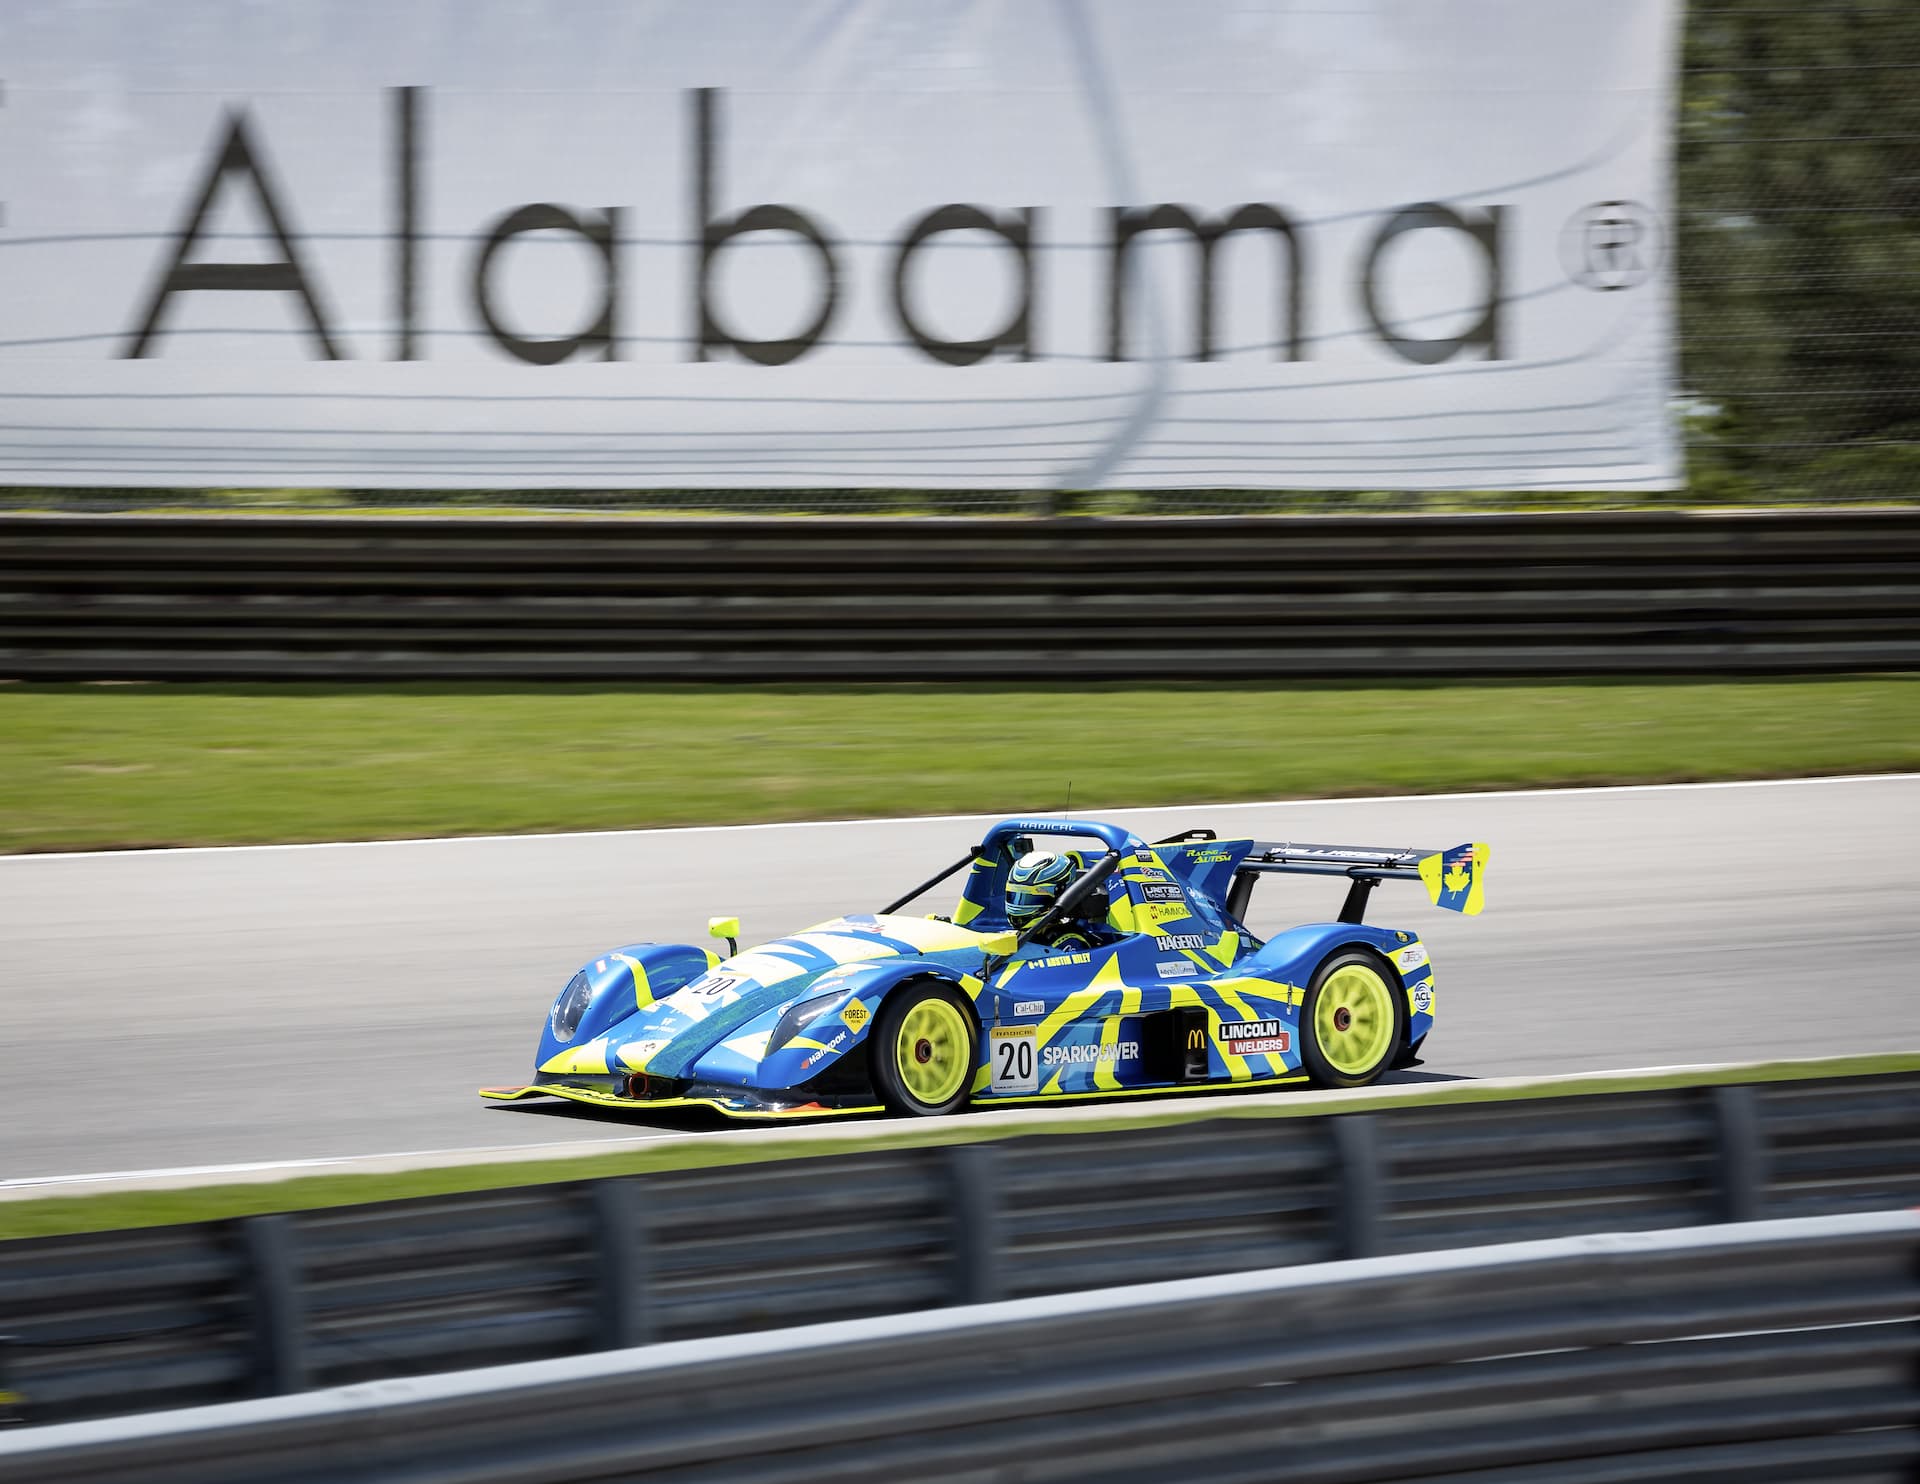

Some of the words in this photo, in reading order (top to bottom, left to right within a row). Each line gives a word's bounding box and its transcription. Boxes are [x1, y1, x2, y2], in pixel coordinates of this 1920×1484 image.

[112, 85, 1516, 366] Alabama
[1019, 821, 1076, 832] RADICAL
[1144, 886, 1181, 895] UNITED
[1155, 934, 1206, 952] HAGERTY
[691, 977, 736, 996] 20
[1414, 992, 1431, 1002] ACL
[844, 1009, 868, 1019] FOREST
[1015, 1002, 1044, 1015] Cal-Chip
[1221, 1021, 1278, 1040] LINCOLN
[808, 1030, 847, 1065] Hankook
[1043, 1041, 1139, 1066] SPARKPOWER
[1234, 1039, 1284, 1054] WELDERS
[999, 1041, 1032, 1081] 20
